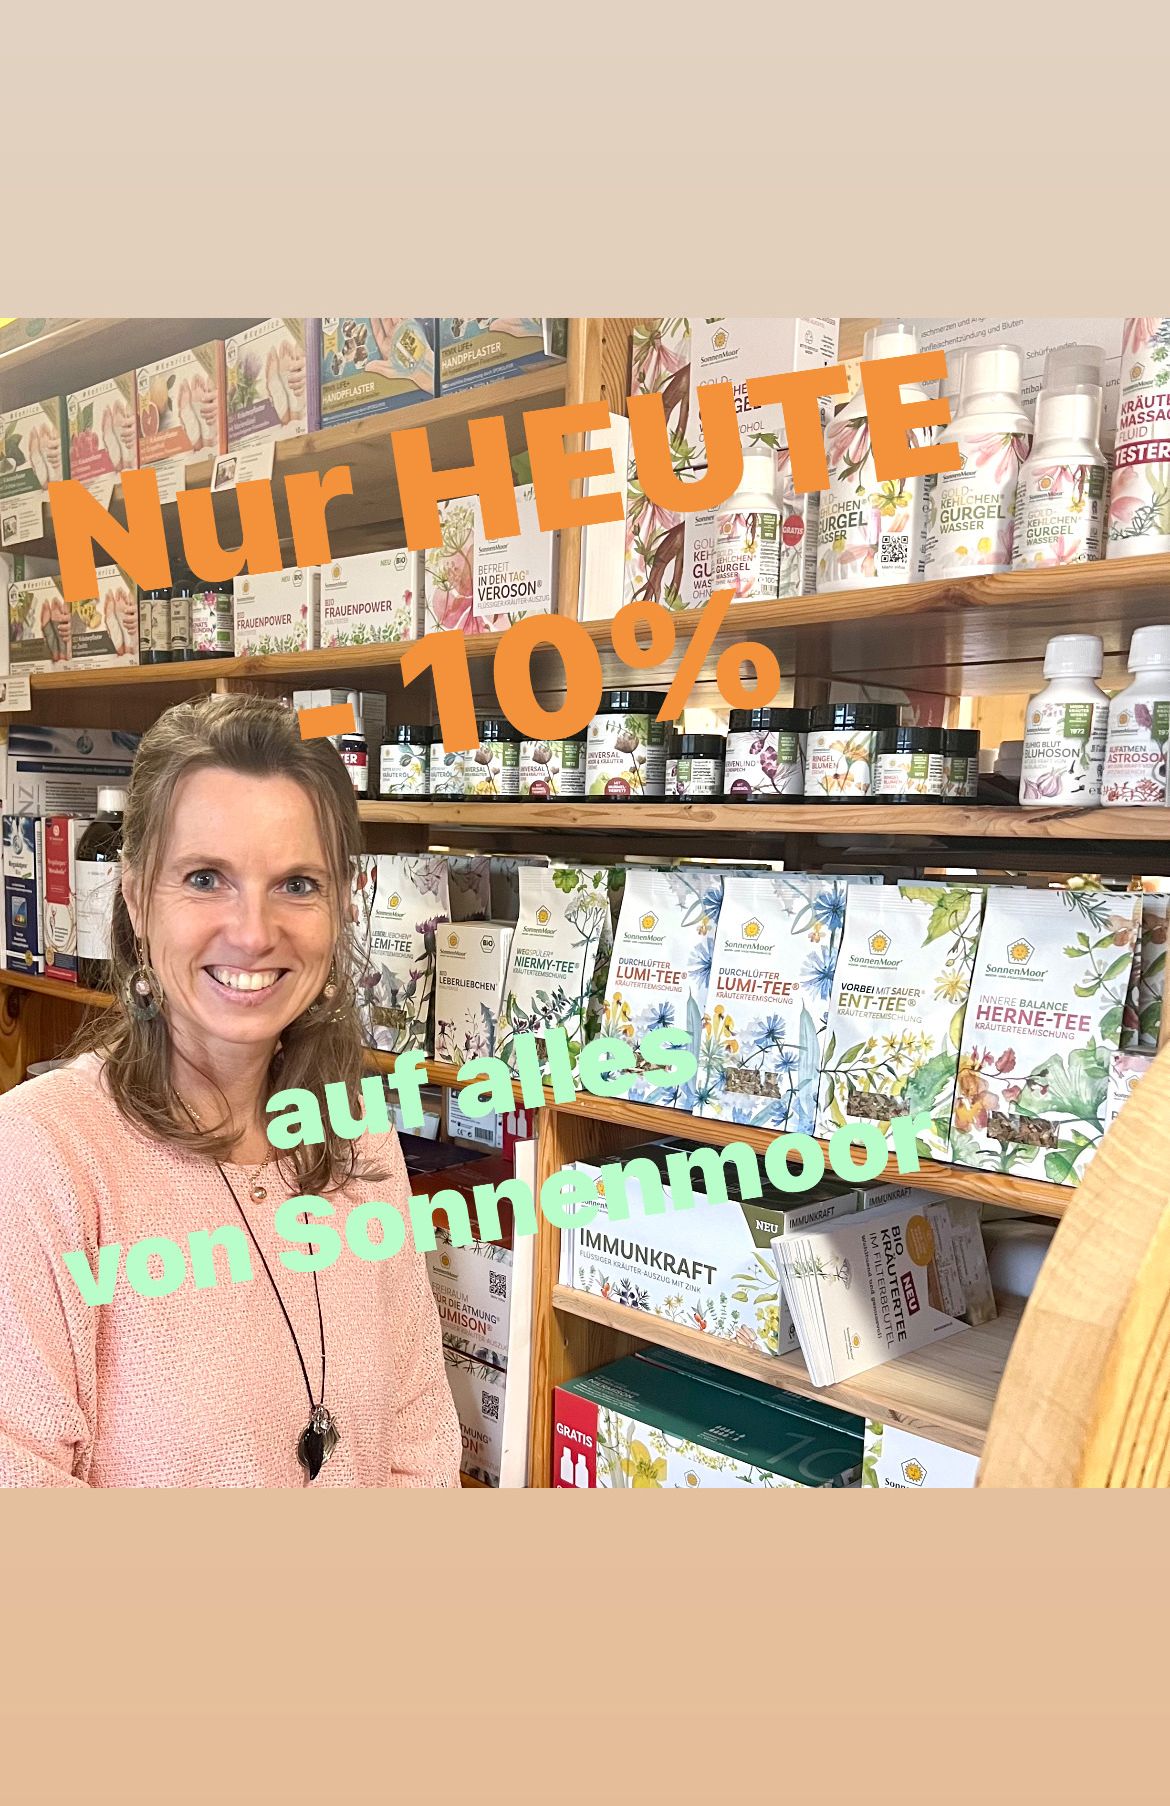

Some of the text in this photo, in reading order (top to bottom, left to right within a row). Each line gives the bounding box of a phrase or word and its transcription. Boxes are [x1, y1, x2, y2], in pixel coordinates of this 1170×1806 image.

[988, 325, 1001, 335] und
[1002, 319, 1024, 331] Bluten
[441, 342, 502, 369] HANDPFLASTER
[1119, 426, 1148, 442] FLUID
[1115, 442, 1170, 466] TESTER
[940, 505, 1005, 523] GURGEL
[783, 526, 805, 535] GRATIS
[940, 521, 984, 534] WASSER
[1027, 525, 1074, 538] GURGEL
[1027, 536, 1059, 546] WASSER
[478, 561, 509, 576] BEFREIT
[716, 563, 750, 573] GURGEL
[716, 572, 738, 580] WASSER
[478, 576, 487, 587] IN
[489, 573, 507, 585] DEN
[324, 600, 392, 619] FRAUENPOWER
[236, 613, 292, 630] FRAUENPOWER
[1042, 740, 1061, 748] BLUT
[1024, 748, 1080, 759] BLUHOSON
[812, 762, 839, 770] BLUMEN
[624, 932, 667, 942] SonnenMoor
[370, 938, 413, 953] LEMI-TEE
[725, 940, 775, 951] SonnenMoor
[619, 957, 671, 969] DURCHLÜFTER
[850, 954, 903, 967] SonnenMoor
[513, 967, 567, 980] KRÄUTERTEEMISCHUNG
[616, 965, 688, 985] LUMI-TEE®
[719, 967, 780, 980] DURCHLÜFTER
[985, 964, 1048, 978] SonnenMoor
[615, 980, 683, 993] KRÄUTERTEEMISCHUNG
[716, 976, 800, 997] LUMI-TEE®
[841, 982, 875, 994] VORBEI
[875, 986, 891, 995] MIT
[716, 992, 794, 1005] KRÄUTERTEEMISCHUNG
[838, 992, 917, 1013] ENT-TEE®
[979, 994, 1069, 1012] INNERE BALANCE
[837, 1008, 923, 1024] KRÄUTERTEEMISCHUNG
[976, 1004, 1092, 1032] HERNE-TEE
[975, 1021, 1075, 1040] KRÄUTERTEEMISCHUNG
[868, 1186, 912, 1208] IMMUNKRAFT
[789, 1206, 835, 1229] IMMUNKRAFT
[755, 1219, 780, 1235] NEU
[892, 1225, 904, 1256] BIO
[580, 1227, 718, 1285] IMMUNKRAFT
[579, 1249, 702, 1295] FLÜSSIGER KRÄUTER-AUSZUG MIT ZINK
[432, 1281, 469, 1302] FREIRAUM
[869, 1232, 895, 1349] IM FILTERBEUTEL
[880, 1228, 907, 1342] KRÄUTERTEE
[902, 1275, 918, 1311] NEU
[448, 1298, 461, 1311] DIE
[556, 1422, 593, 1448] GRATIS
